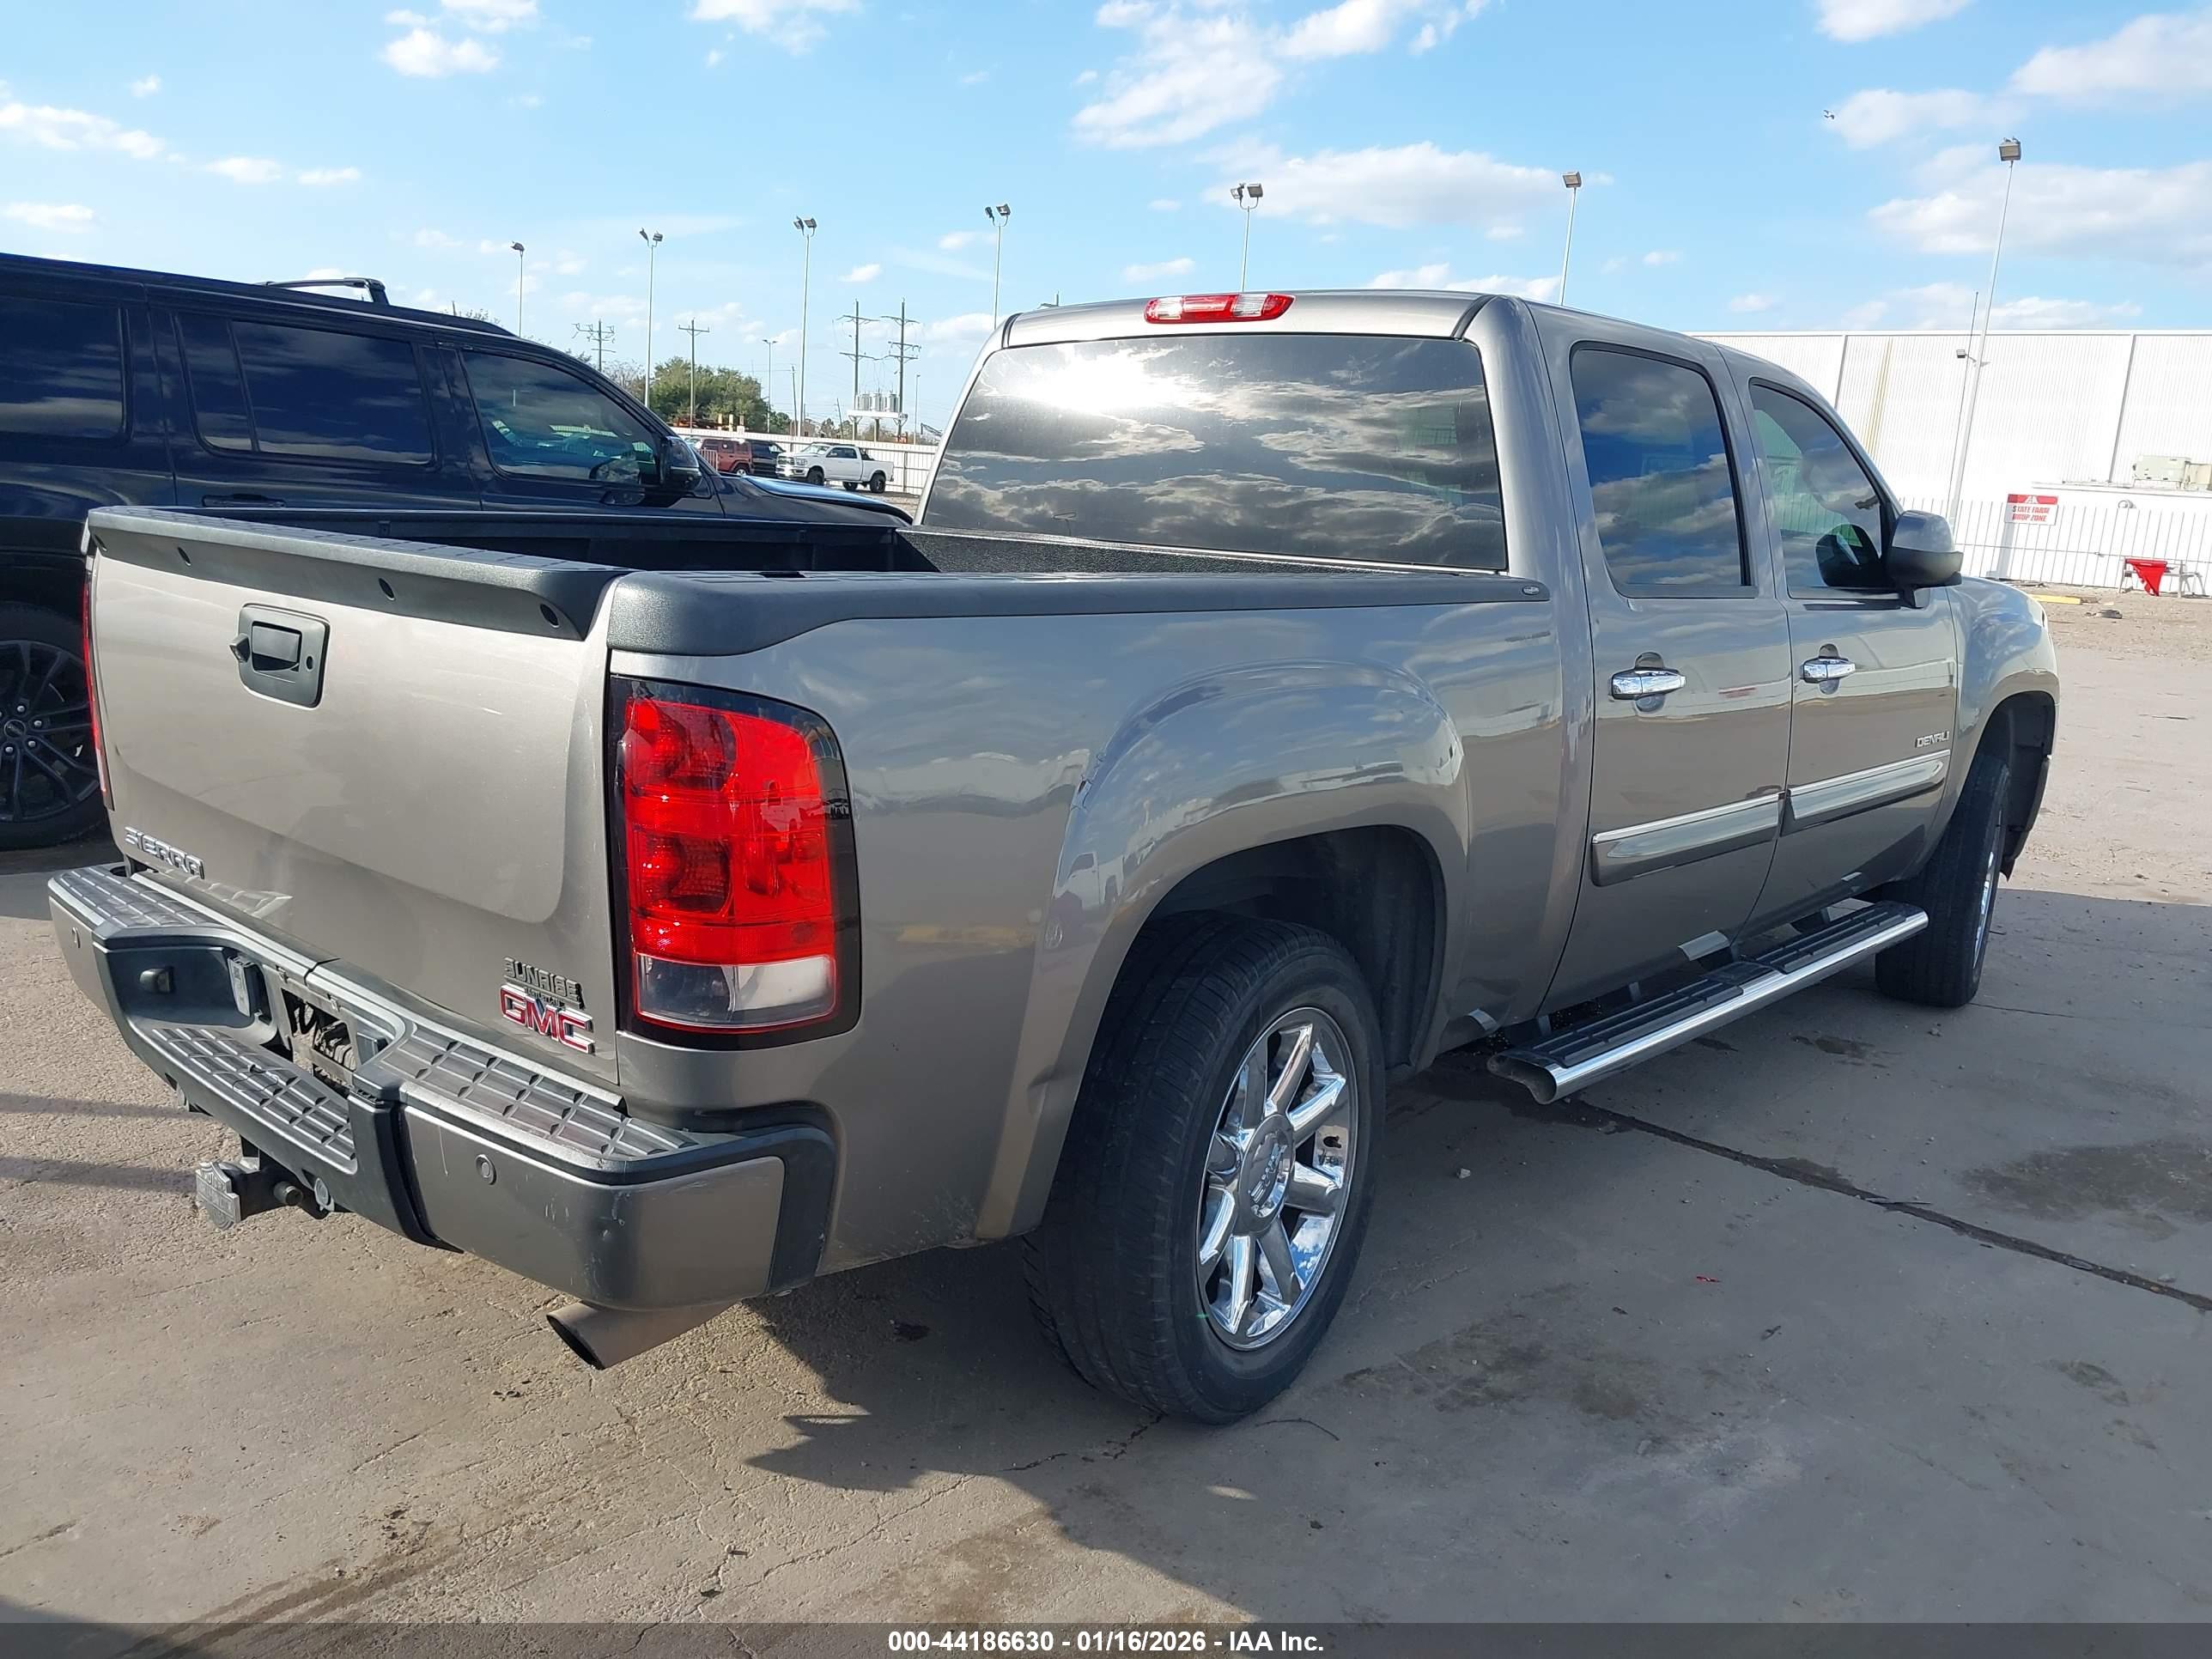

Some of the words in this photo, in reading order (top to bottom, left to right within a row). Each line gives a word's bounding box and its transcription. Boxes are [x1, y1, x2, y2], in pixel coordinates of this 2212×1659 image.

[1915, 730, 1950, 748] DENALI
[125, 827, 205, 879] SIERRA
[504, 957, 584, 1003] SUNRISE
[500, 982, 596, 1054] GMC
